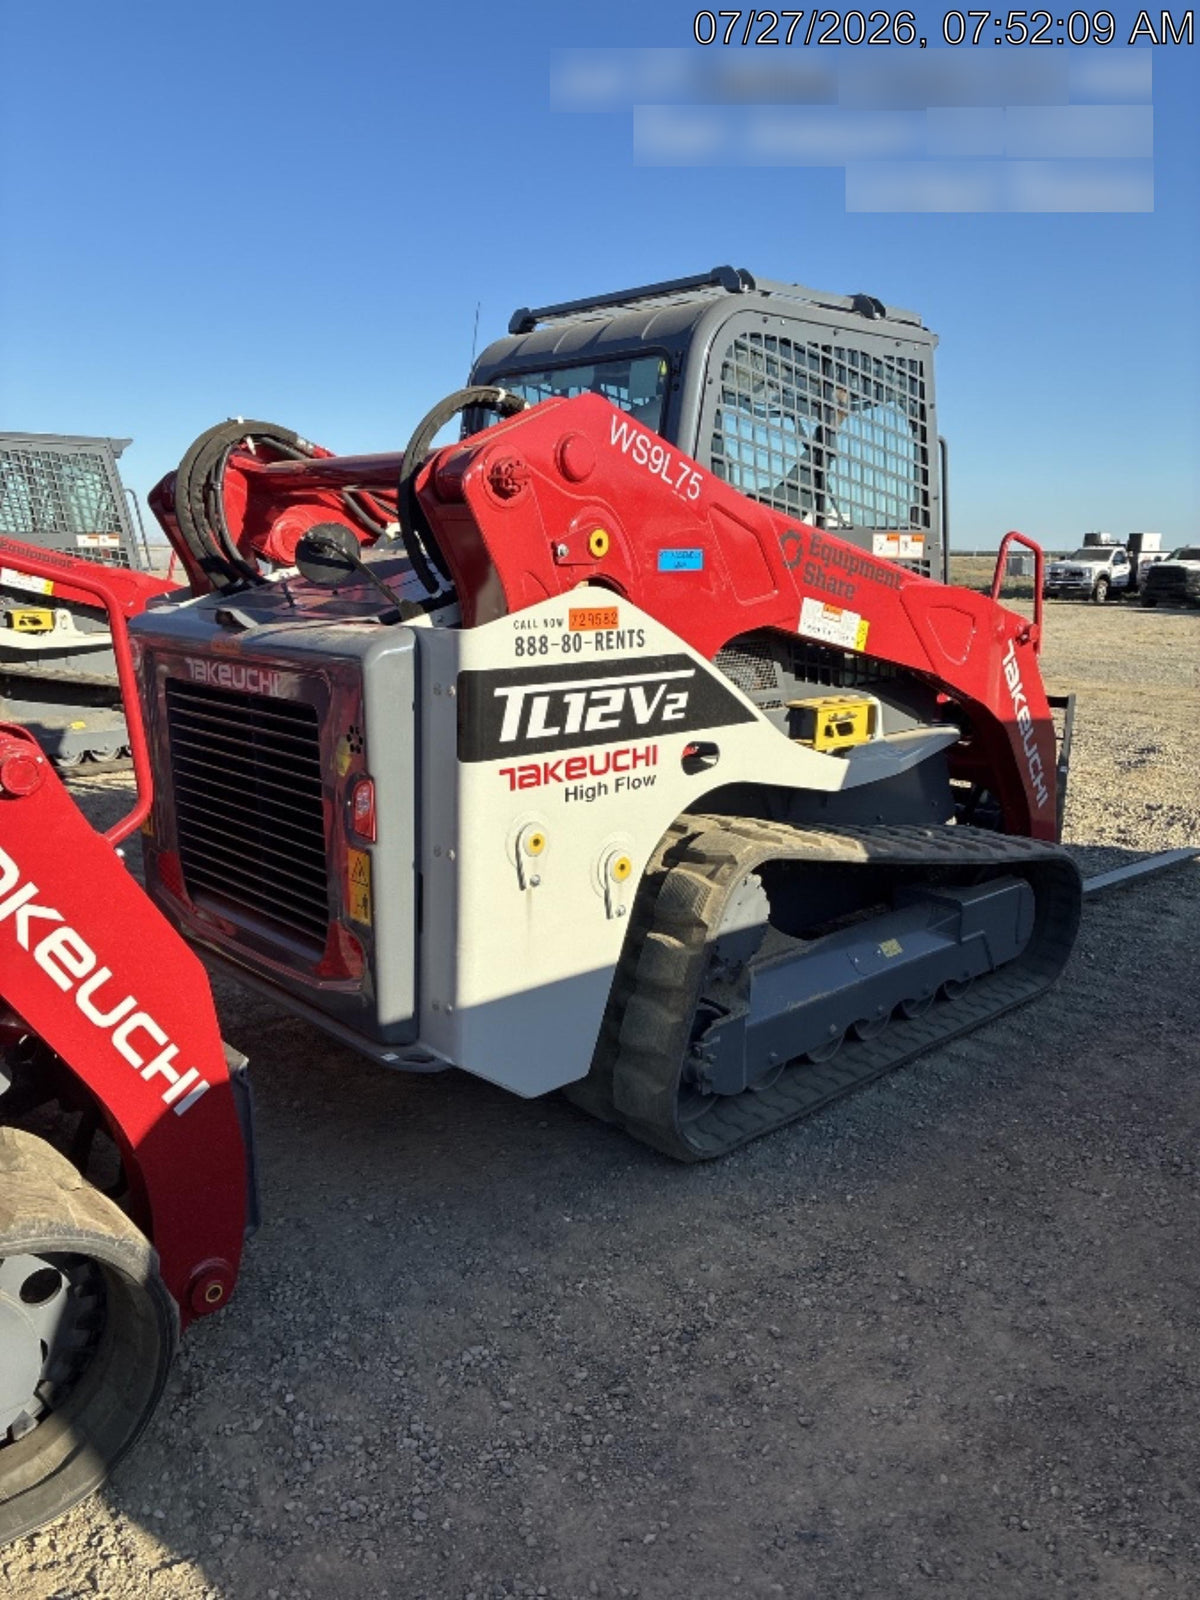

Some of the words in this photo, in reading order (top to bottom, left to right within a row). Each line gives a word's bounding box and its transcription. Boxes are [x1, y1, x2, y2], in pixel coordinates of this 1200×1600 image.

[609, 413, 704, 500] WS9L75
[803, 560, 856, 601] Share
[809, 532, 903, 591] Equipment
[513, 618, 539, 630] CALL
[543, 618, 565, 629] NOW
[514, 628, 646, 657] 888-80-RENTS
[493, 668, 696, 743] TL12V2
[564, 781, 609, 803] High
[614, 773, 657, 795] Flow
